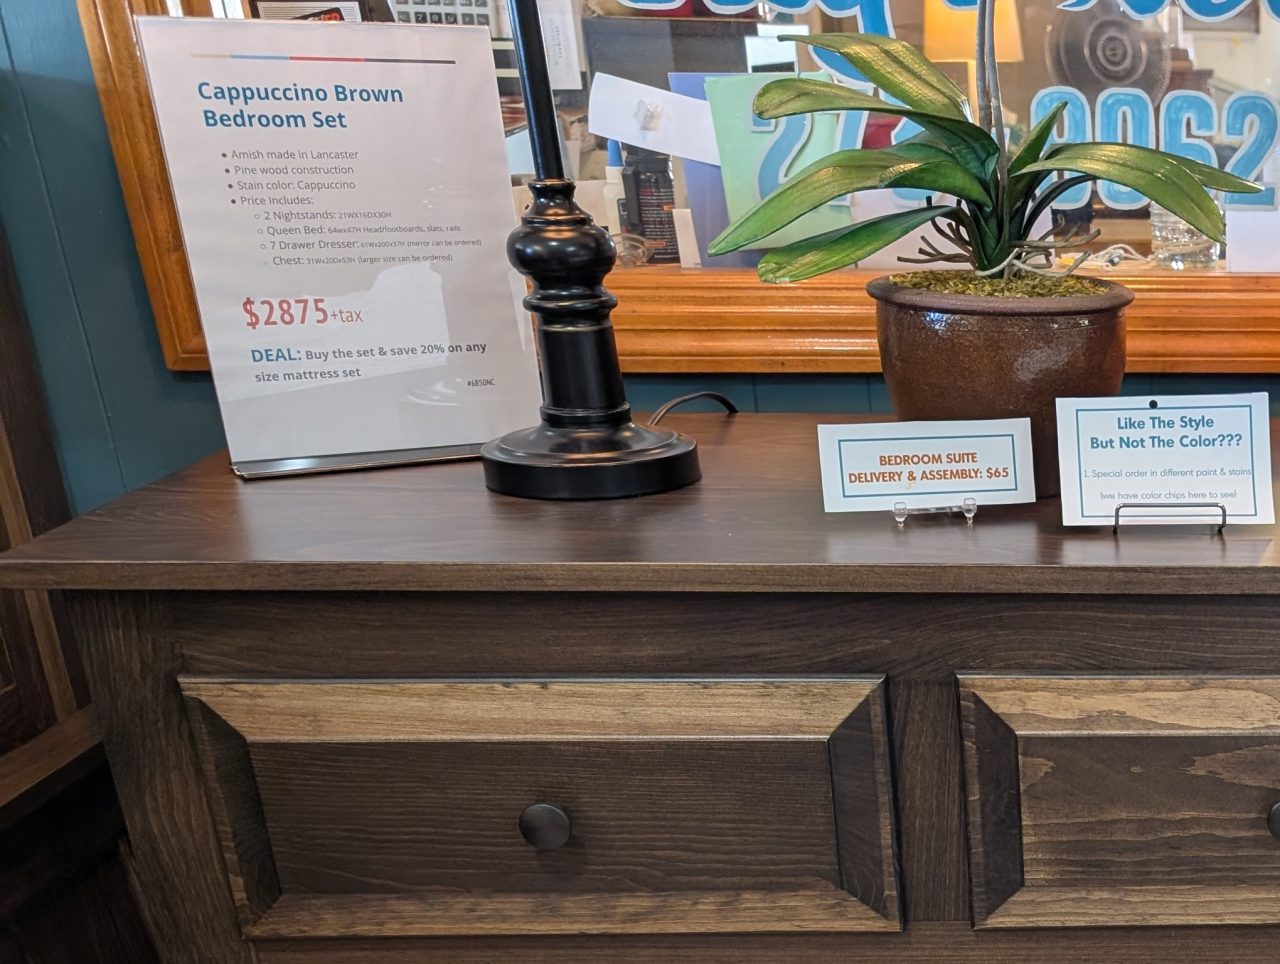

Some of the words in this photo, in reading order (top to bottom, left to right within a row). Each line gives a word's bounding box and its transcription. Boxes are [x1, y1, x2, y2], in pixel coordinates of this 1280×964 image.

[198, 82, 328, 105] Cappuccino
[334, 84, 404, 102] Brown
[203, 109, 306, 128] Bedroom
[312, 111, 347, 128] Set
[231, 150, 264, 160] Amish
[267, 150, 296, 160] made
[299, 150, 308, 159] in
[310, 150, 359, 160] Lancaster
[234, 165, 257, 175] Pine
[260, 165, 288, 175] wood
[291, 165, 354, 175] construction
[237, 181, 263, 190] Stain
[266, 181, 295, 190] color:
[297, 181, 356, 192] Cappuccino
[240, 196, 266, 205] Price
[269, 196, 315, 205] Includes:
[264, 211, 271, 220] 2
[273, 210, 336, 222] Nightstands:
[267, 226, 301, 236] Queen
[303, 225, 327, 235] Bed:
[270, 241, 276, 250] 7
[279, 241, 316, 250] Drawer
[318, 239, 360, 249] Dresser:
[454, 238, 482, 247] ordered)
[273, 256, 305, 265] Chest:
[423, 254, 453, 262] ordered)
[251, 347, 302, 363] DEAL:
[306, 349, 329, 362] Buy
[332, 348, 354, 359] the
[357, 347, 375, 358] set
[378, 346, 388, 357] &
[390, 346, 418, 357] save
[420, 344, 445, 354] 20%
[447, 344, 462, 353] on
[465, 343, 487, 354] any
[255, 371, 279, 383] size
[283, 368, 339, 381] mattress
[342, 367, 362, 378] set
[1117, 417, 1146, 430] Like
[1149, 416, 1175, 429] The
[1180, 415, 1214, 430] Style
[1090, 436, 1115, 449] But
[1119, 435, 1146, 449] Not
[1149, 434, 1175, 448] The
[1179, 433, 1243, 448] Color???
[879, 453, 943, 466] BEDROOM
[946, 452, 978, 464] SUITE
[849, 470, 903, 484] DELIVERY
[907, 470, 916, 482] &
[920, 467, 983, 481] ASSEMBLY:
[986, 466, 1009, 479] $65
[1092, 469, 1123, 479] Special
[1125, 469, 1148, 478] order
[1150, 469, 1158, 477] in
[1160, 468, 1194, 478] different
[1196, 468, 1217, 479] paint
[1219, 467, 1226, 476] &
[1228, 467, 1252, 476] stains
[1100, 491, 1115, 500] (we
[1117, 490, 1138, 500] have
[1140, 490, 1162, 499] color
[1164, 490, 1186, 501] chips
[1188, 490, 1207, 499] here
[1208, 490, 1218, 498] to
[1219, 489, 1237, 499] see)
